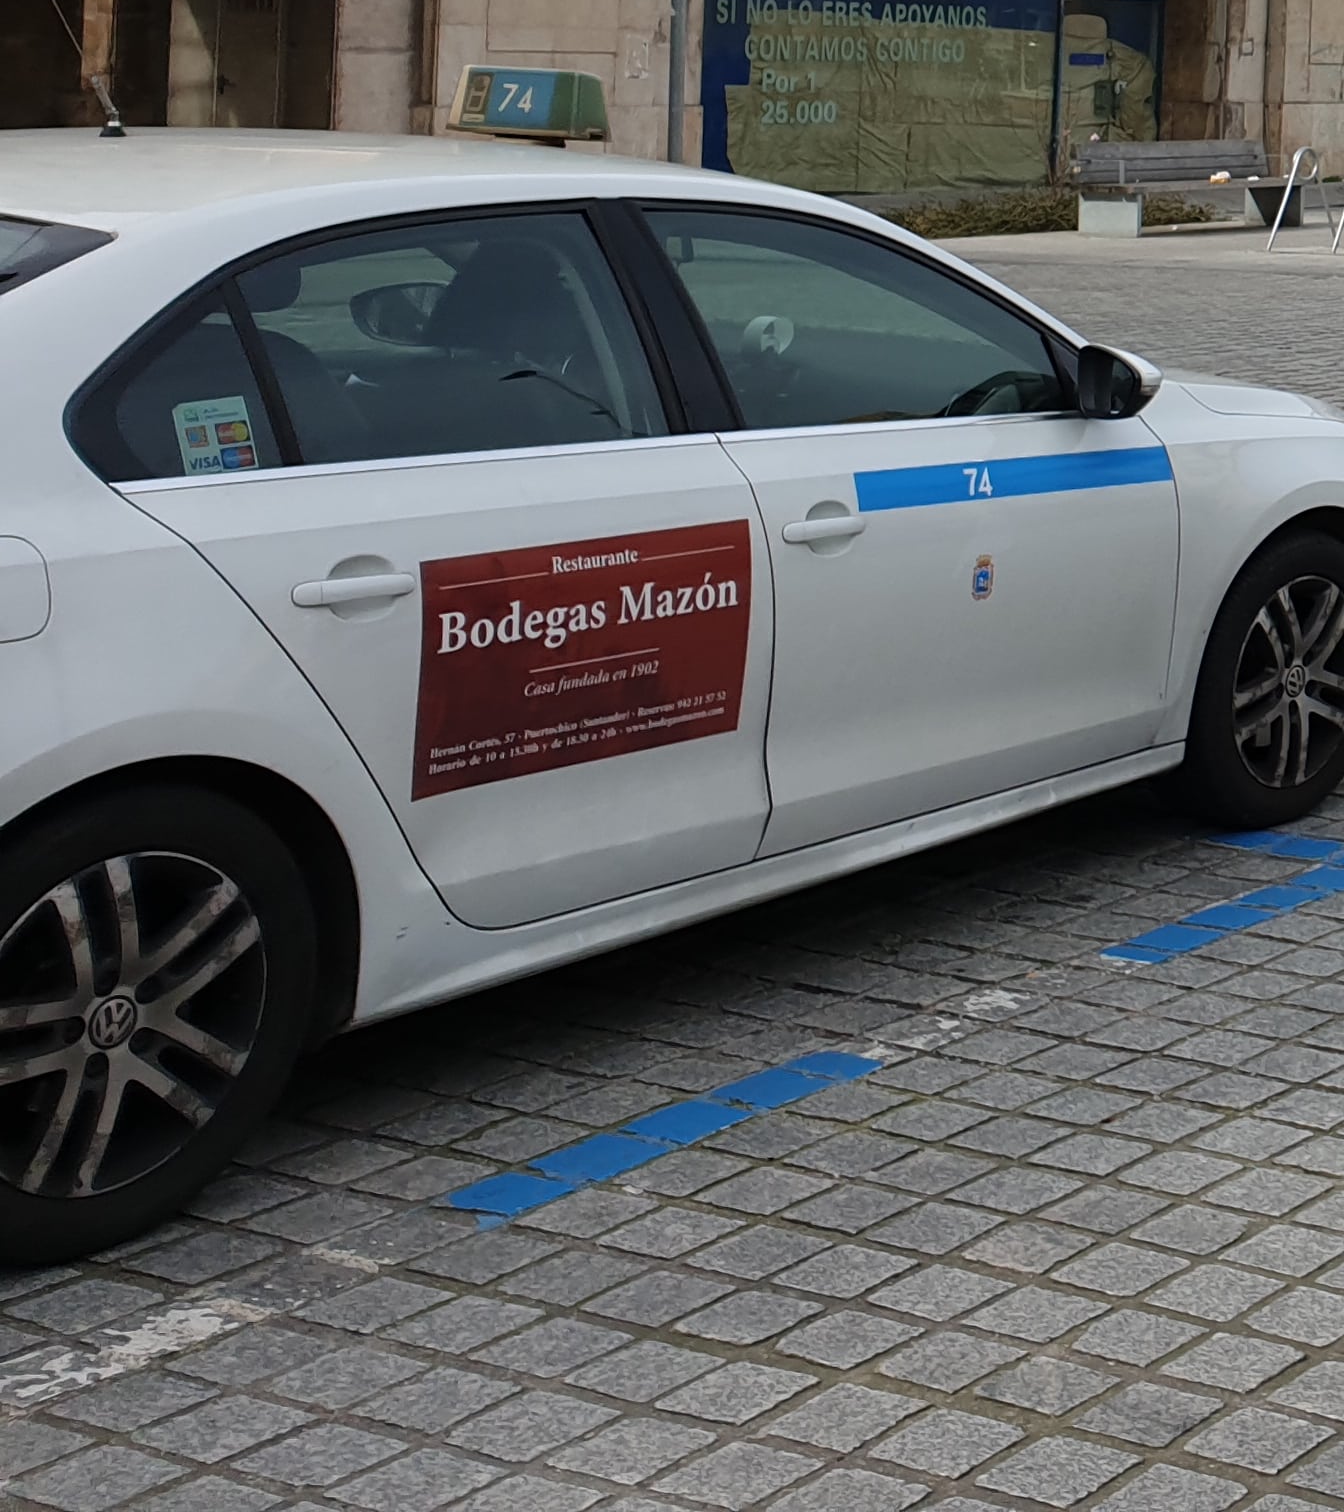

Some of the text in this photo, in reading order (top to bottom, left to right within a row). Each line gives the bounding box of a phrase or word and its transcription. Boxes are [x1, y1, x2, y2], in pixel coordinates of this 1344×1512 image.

[787, 0, 812, 26] LO
[822, 1, 872, 27] ERES
[744, 34, 965, 62] CONTAMOS CONTIGO
[761, 70, 799, 93] Por
[498, 83, 533, 113] 74
[761, 100, 838, 124] 25.000
[189, 456, 220, 470] VISA
[962, 467, 993, 496] 74
[552, 549, 639, 574] Restaurante
[437, 572, 738, 654] Bodegas Mazón
[524, 660, 659, 697] Casa fundada en 1902
[469, 754, 481, 767] de
[486, 751, 496, 763] 10
[551, 738, 563, 749] de
